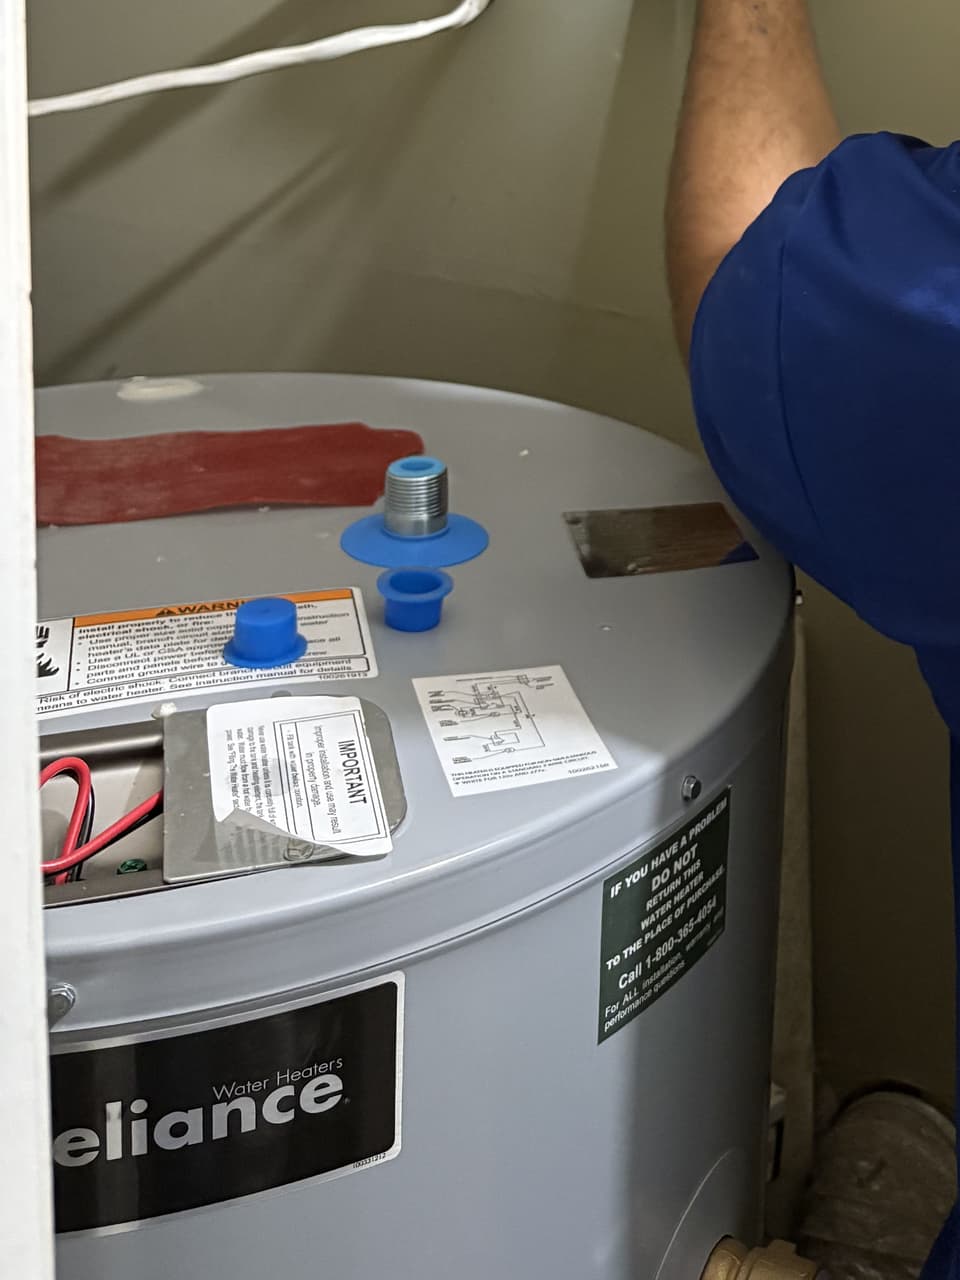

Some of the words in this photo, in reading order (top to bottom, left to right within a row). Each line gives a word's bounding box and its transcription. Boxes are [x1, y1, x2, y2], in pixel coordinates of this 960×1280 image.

[178, 601, 246, 615] WARN
[39, 695, 65, 705] Risk
[83, 685, 125, 696] electric
[90, 693, 123, 702] water
[305, 759, 318, 782] property
[318, 750, 332, 779] installation
[338, 740, 367, 806] IMPORTANT
[324, 781, 334, 790] and
[326, 791, 335, 802] use
[326, 803, 337, 815] may
[330, 817, 341, 833] result
[610, 882, 622, 898] IF
[625, 864, 649, 888] YOU
[651, 842, 678, 870] HAVE
[680, 836, 687, 848] A
[689, 797, 727, 840] PROBLEM
[652, 868, 671, 892] DO
[673, 843, 698, 875] NOT
[646, 876, 681, 911] RETURN
[683, 859, 701, 880] THIS
[640, 900, 672, 930] WATER
[674, 871, 704, 905] HEATER
[606, 955, 620, 971] TO
[623, 938, 643, 959] THE
[645, 915, 673, 944] PLACE
[674, 903, 685, 919] OF
[619, 962, 642, 989] Call
[604, 989, 652, 1032] performance
[605, 1001, 619, 1017] For
[623, 987, 639, 1005] ALL
[212, 1077, 269, 1101] Water
[277, 1056, 344, 1086] Heaters
[53, 1073, 344, 1167] eliance
